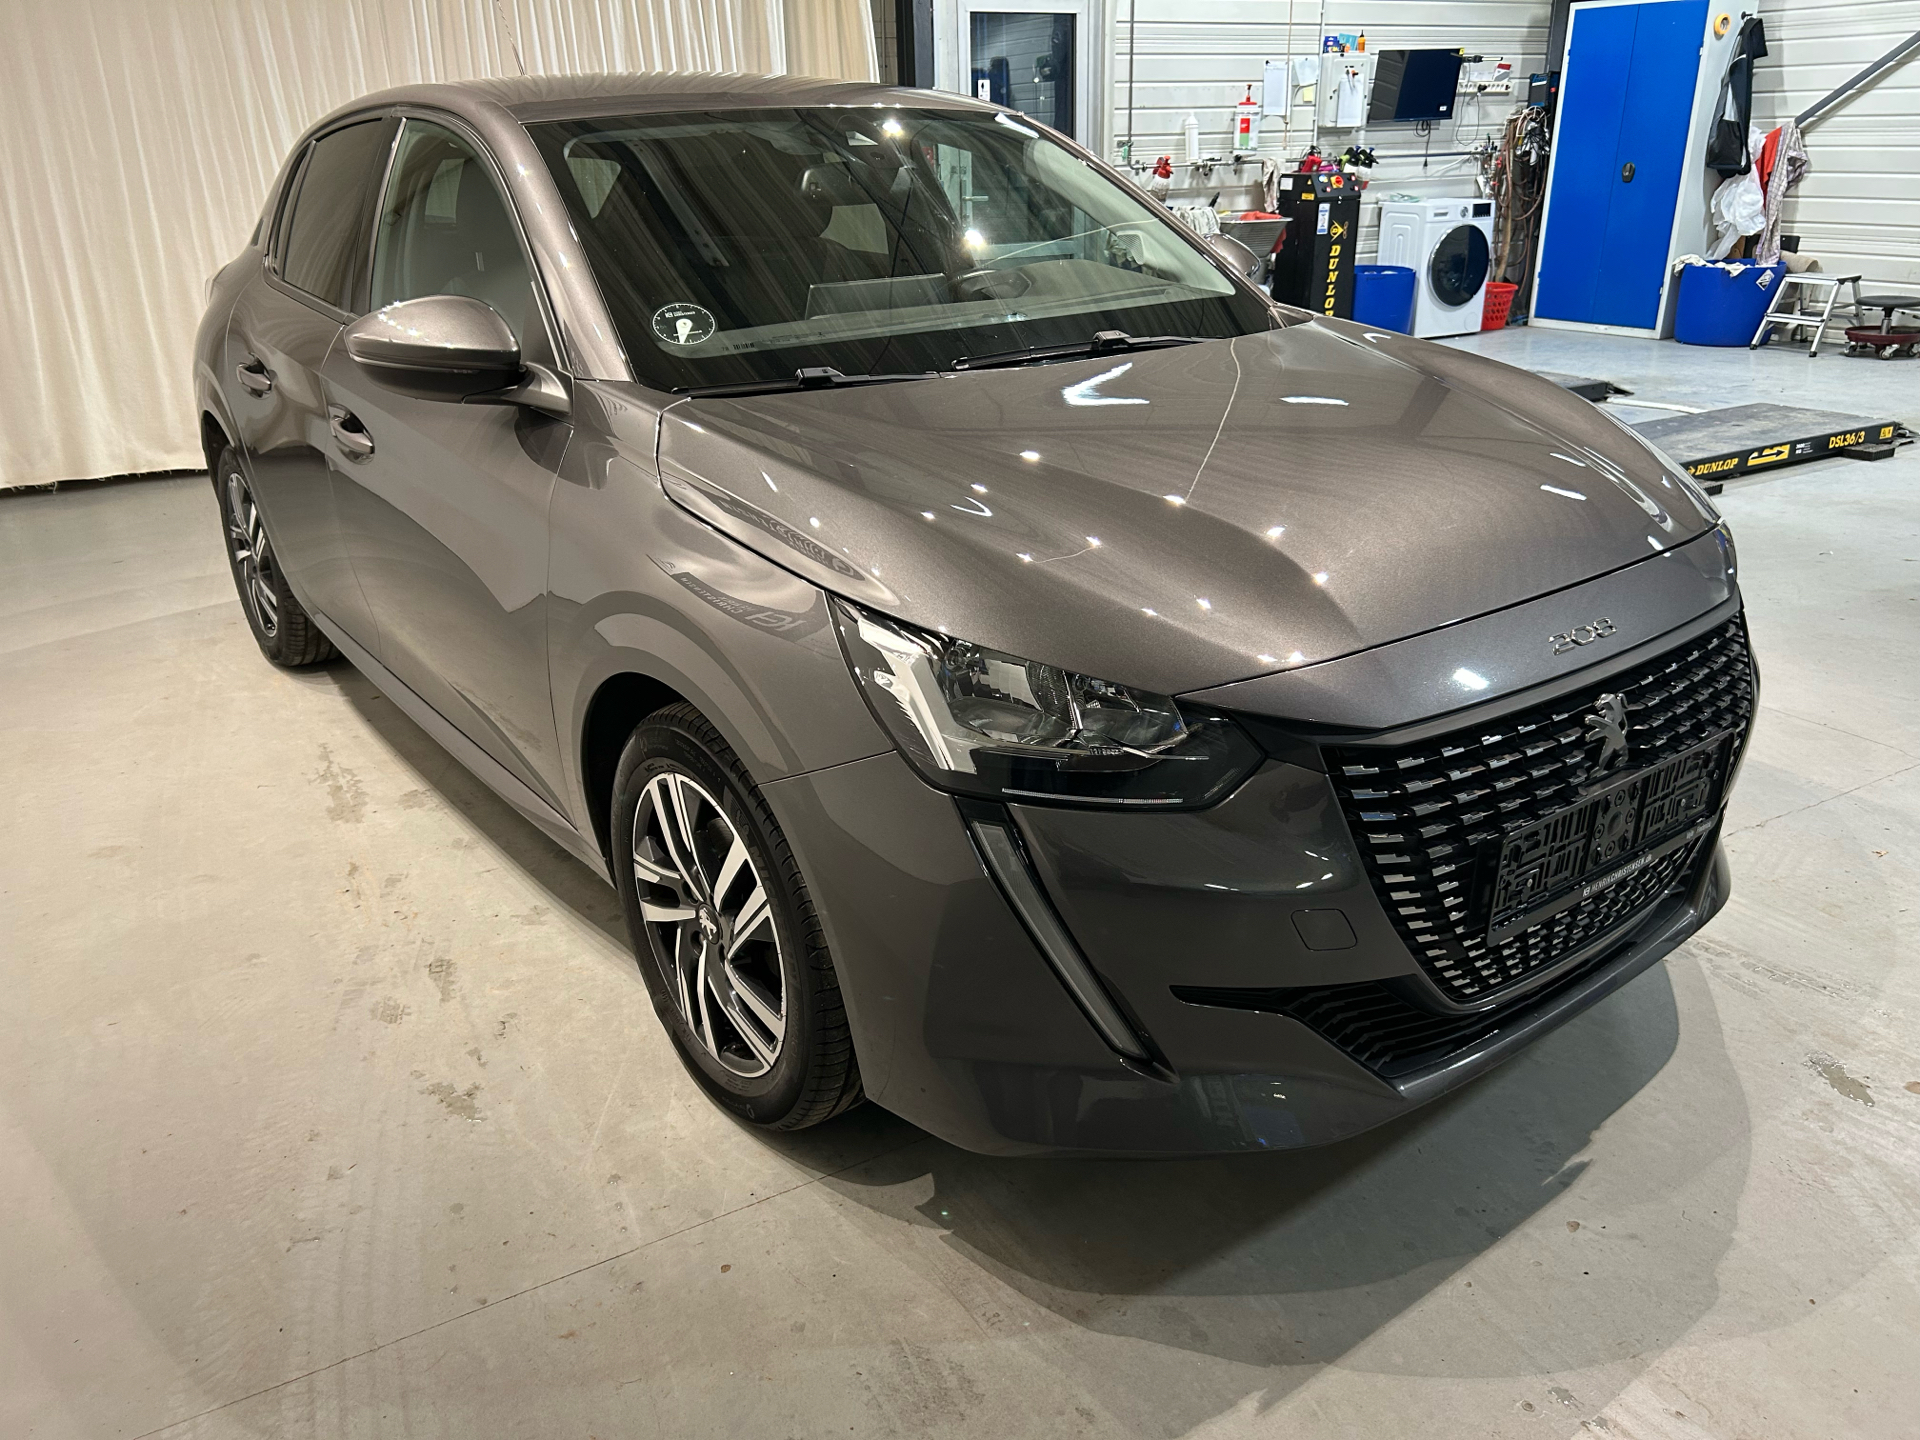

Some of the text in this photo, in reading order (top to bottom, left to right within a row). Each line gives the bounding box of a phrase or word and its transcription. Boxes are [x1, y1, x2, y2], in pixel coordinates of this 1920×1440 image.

[1828, 430, 1866, 449] DSL36/3
[1694, 457, 1739, 476] DUNLOP
[1548, 617, 1617, 656] 208
